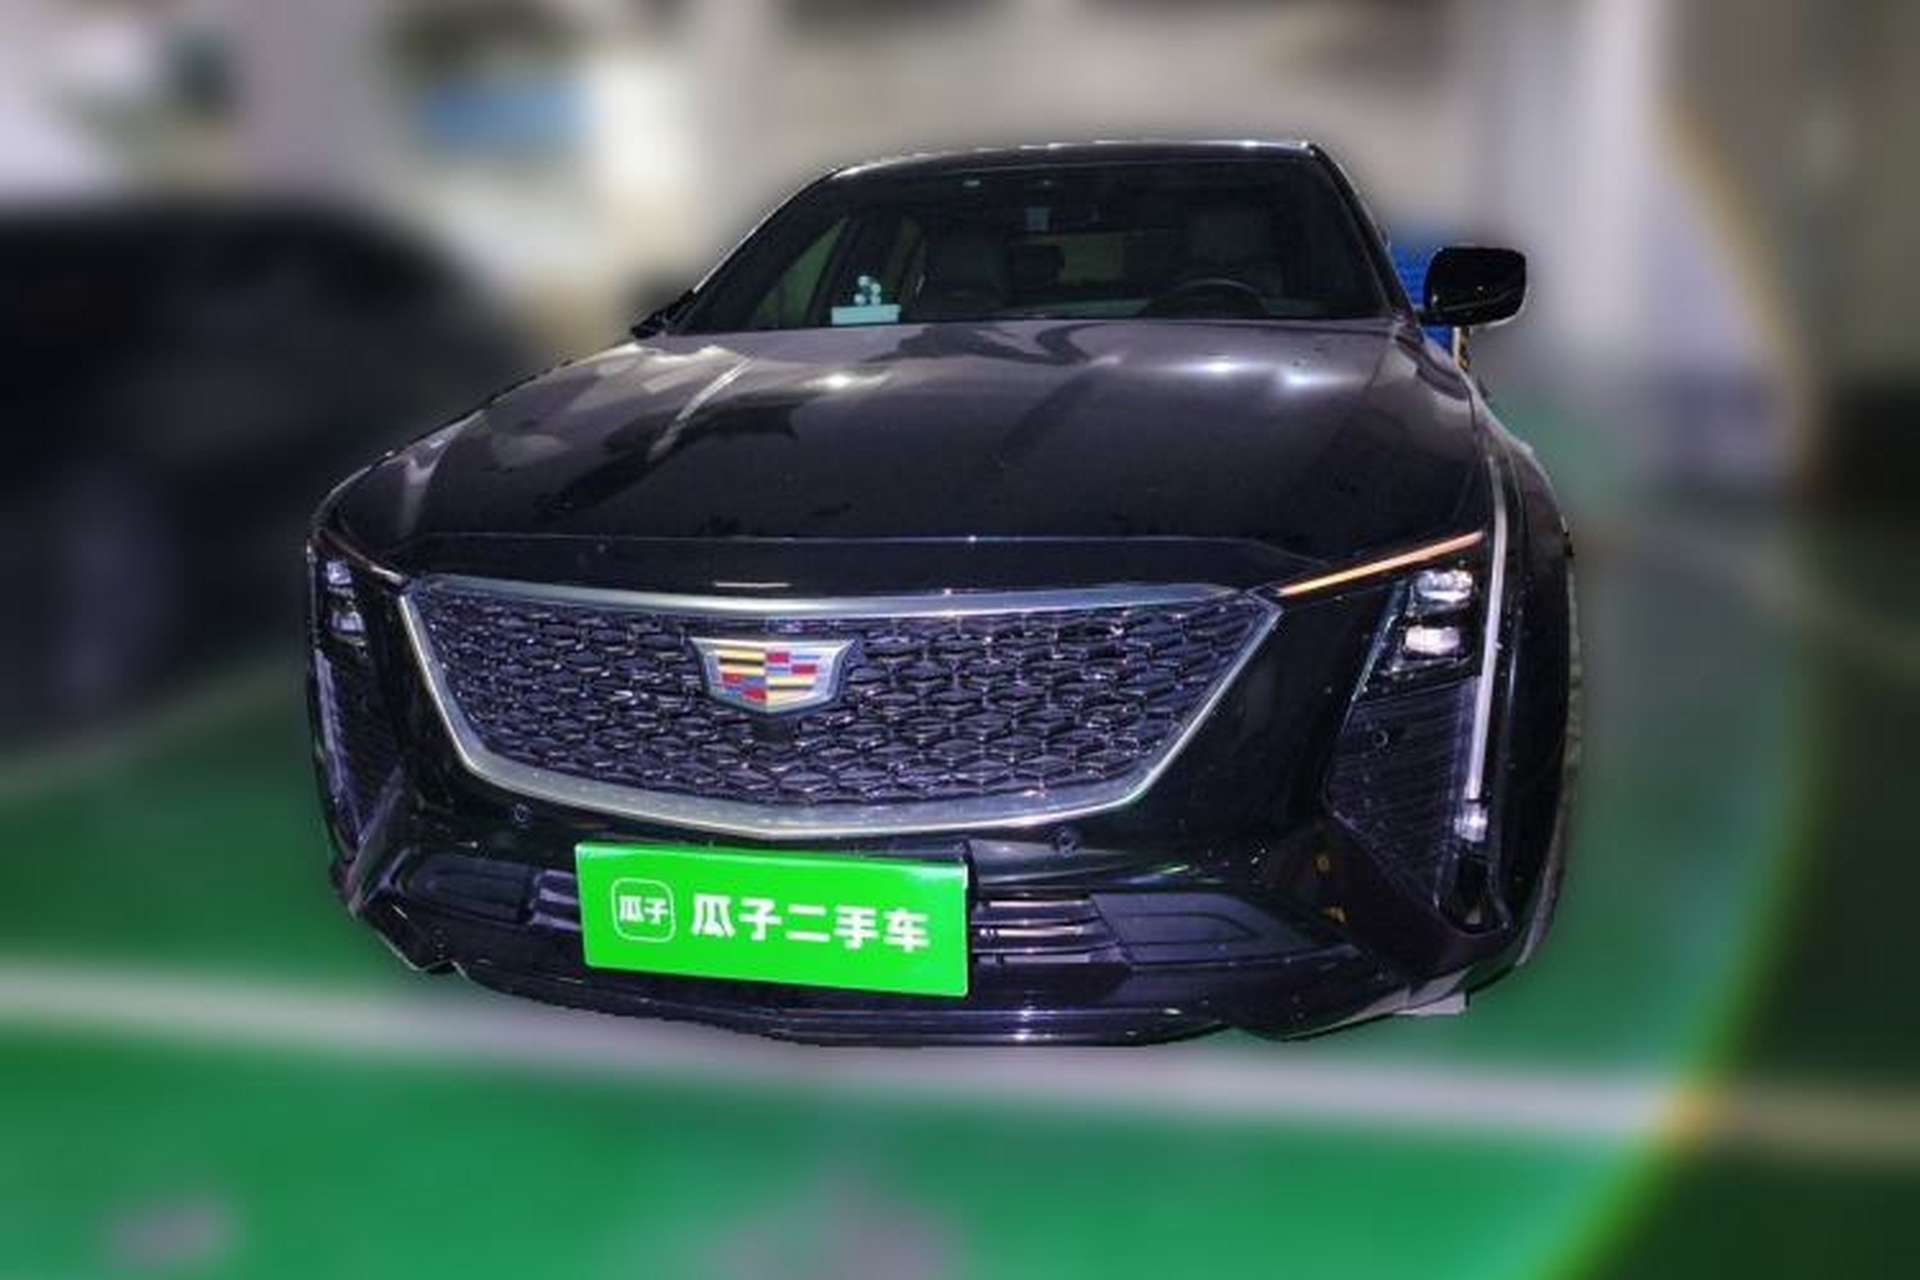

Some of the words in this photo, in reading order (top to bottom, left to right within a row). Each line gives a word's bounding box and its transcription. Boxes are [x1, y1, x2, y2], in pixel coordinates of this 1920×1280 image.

[618, 895, 669, 925] 瓜子
[691, 893, 931, 953] 瓜子二手车
